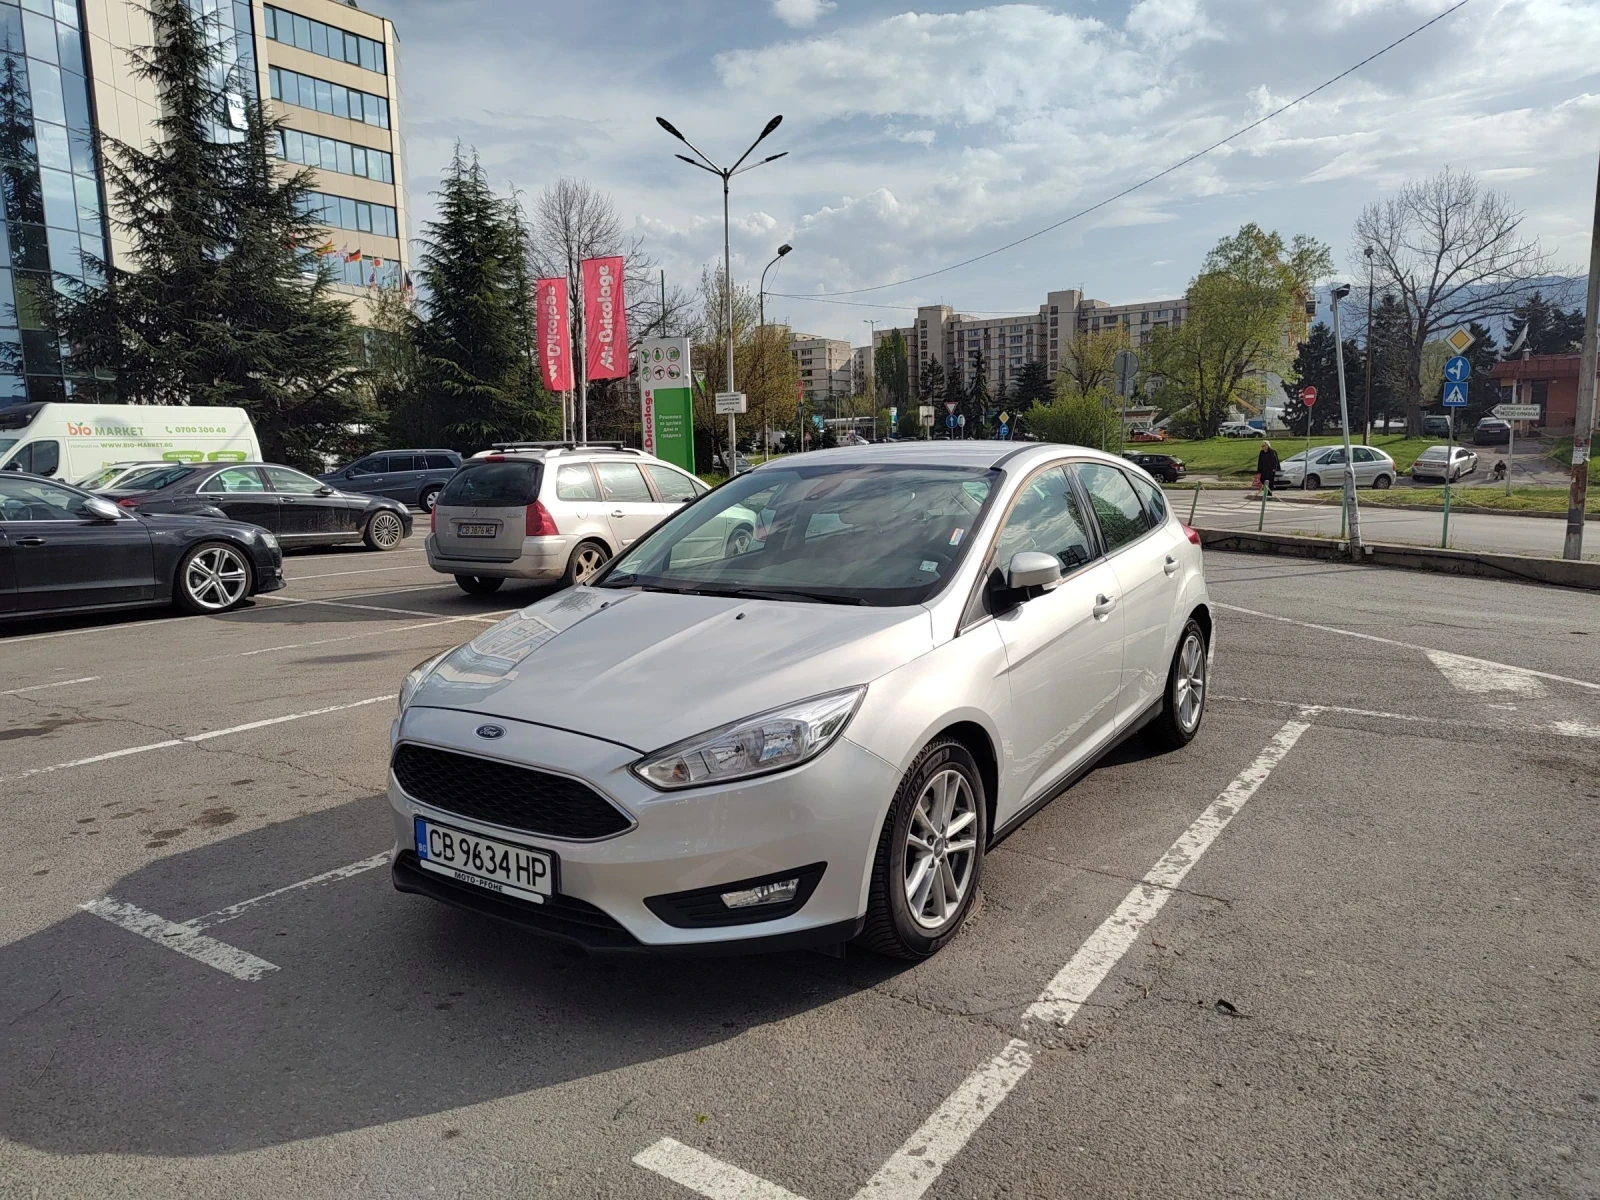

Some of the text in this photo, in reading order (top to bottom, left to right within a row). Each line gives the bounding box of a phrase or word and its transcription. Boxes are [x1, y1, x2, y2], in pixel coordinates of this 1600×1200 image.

[67, 422, 144, 436] bio MARKET
[479, 726, 499, 737] Ford
[418, 842, 428, 853] BG
